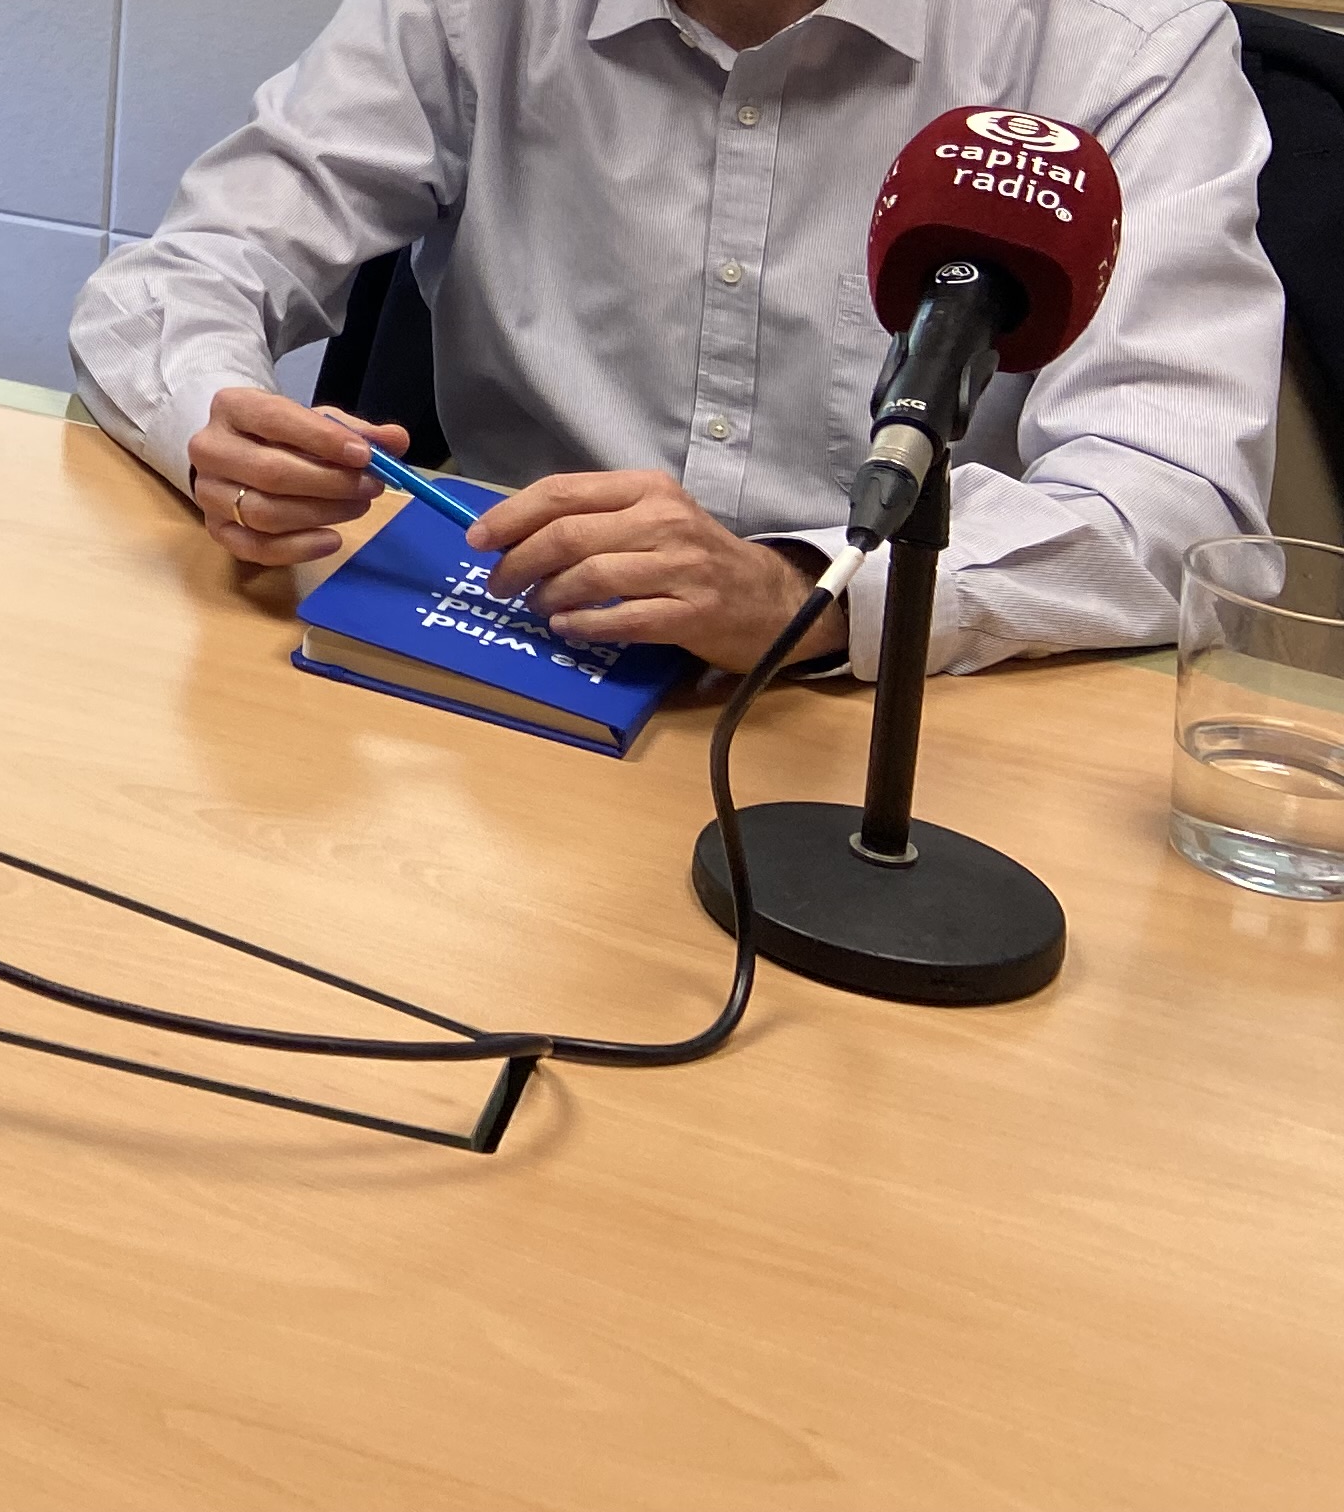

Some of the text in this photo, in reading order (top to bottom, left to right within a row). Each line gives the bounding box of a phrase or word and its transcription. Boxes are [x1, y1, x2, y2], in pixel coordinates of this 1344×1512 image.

[934, 143, 1087, 194] capital
[952, 165, 1061, 211] radio
[415, 606, 609, 685] be wind.
